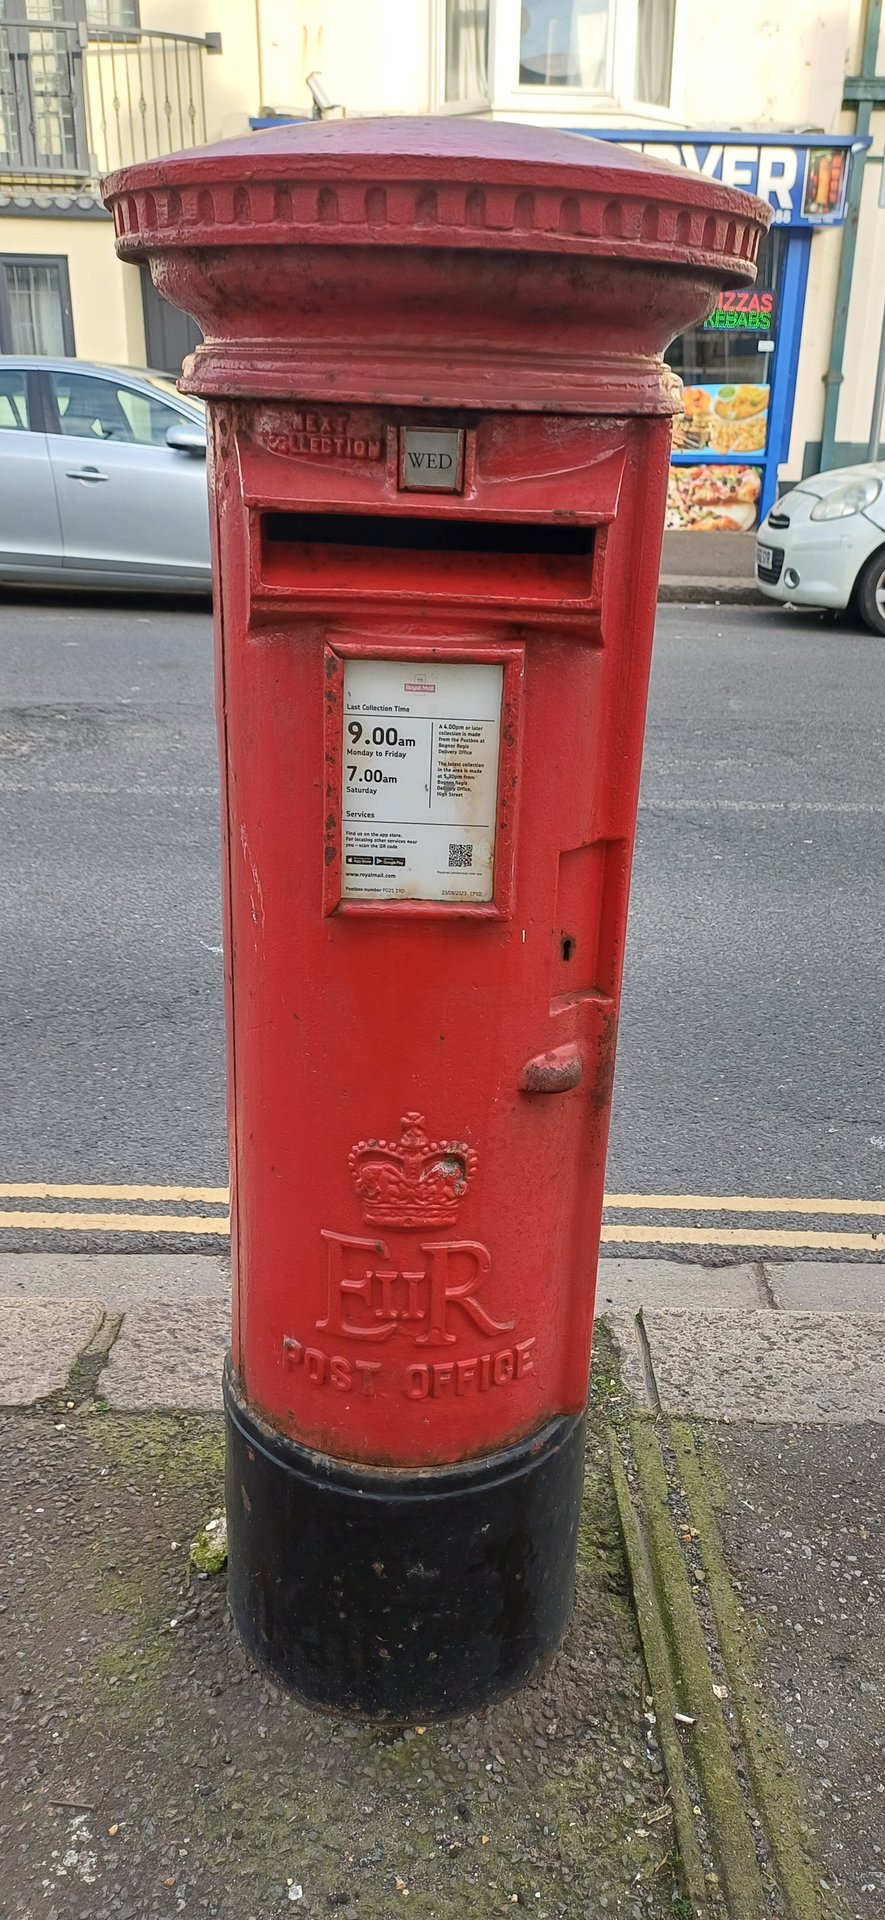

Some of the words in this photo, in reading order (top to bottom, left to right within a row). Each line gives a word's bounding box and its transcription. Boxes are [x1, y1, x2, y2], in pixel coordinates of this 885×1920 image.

[718, 291, 774, 312] IZZAS
[293, 414, 348, 434] NEXT
[269, 434, 381, 460] COLLECTION
[407, 452, 453, 470] WED
[362, 704, 392, 712] Collection
[348, 721, 416, 747] 9.00am
[346, 748, 374, 758] Monday
[384, 750, 406, 760] Friday
[346, 766, 398, 784] 7.00am
[346, 786, 378, 796] Saturday
[346, 810, 375, 818] Services
[283, 1334, 382, 1398] POST
[404, 1336, 538, 1399] OFFICE
